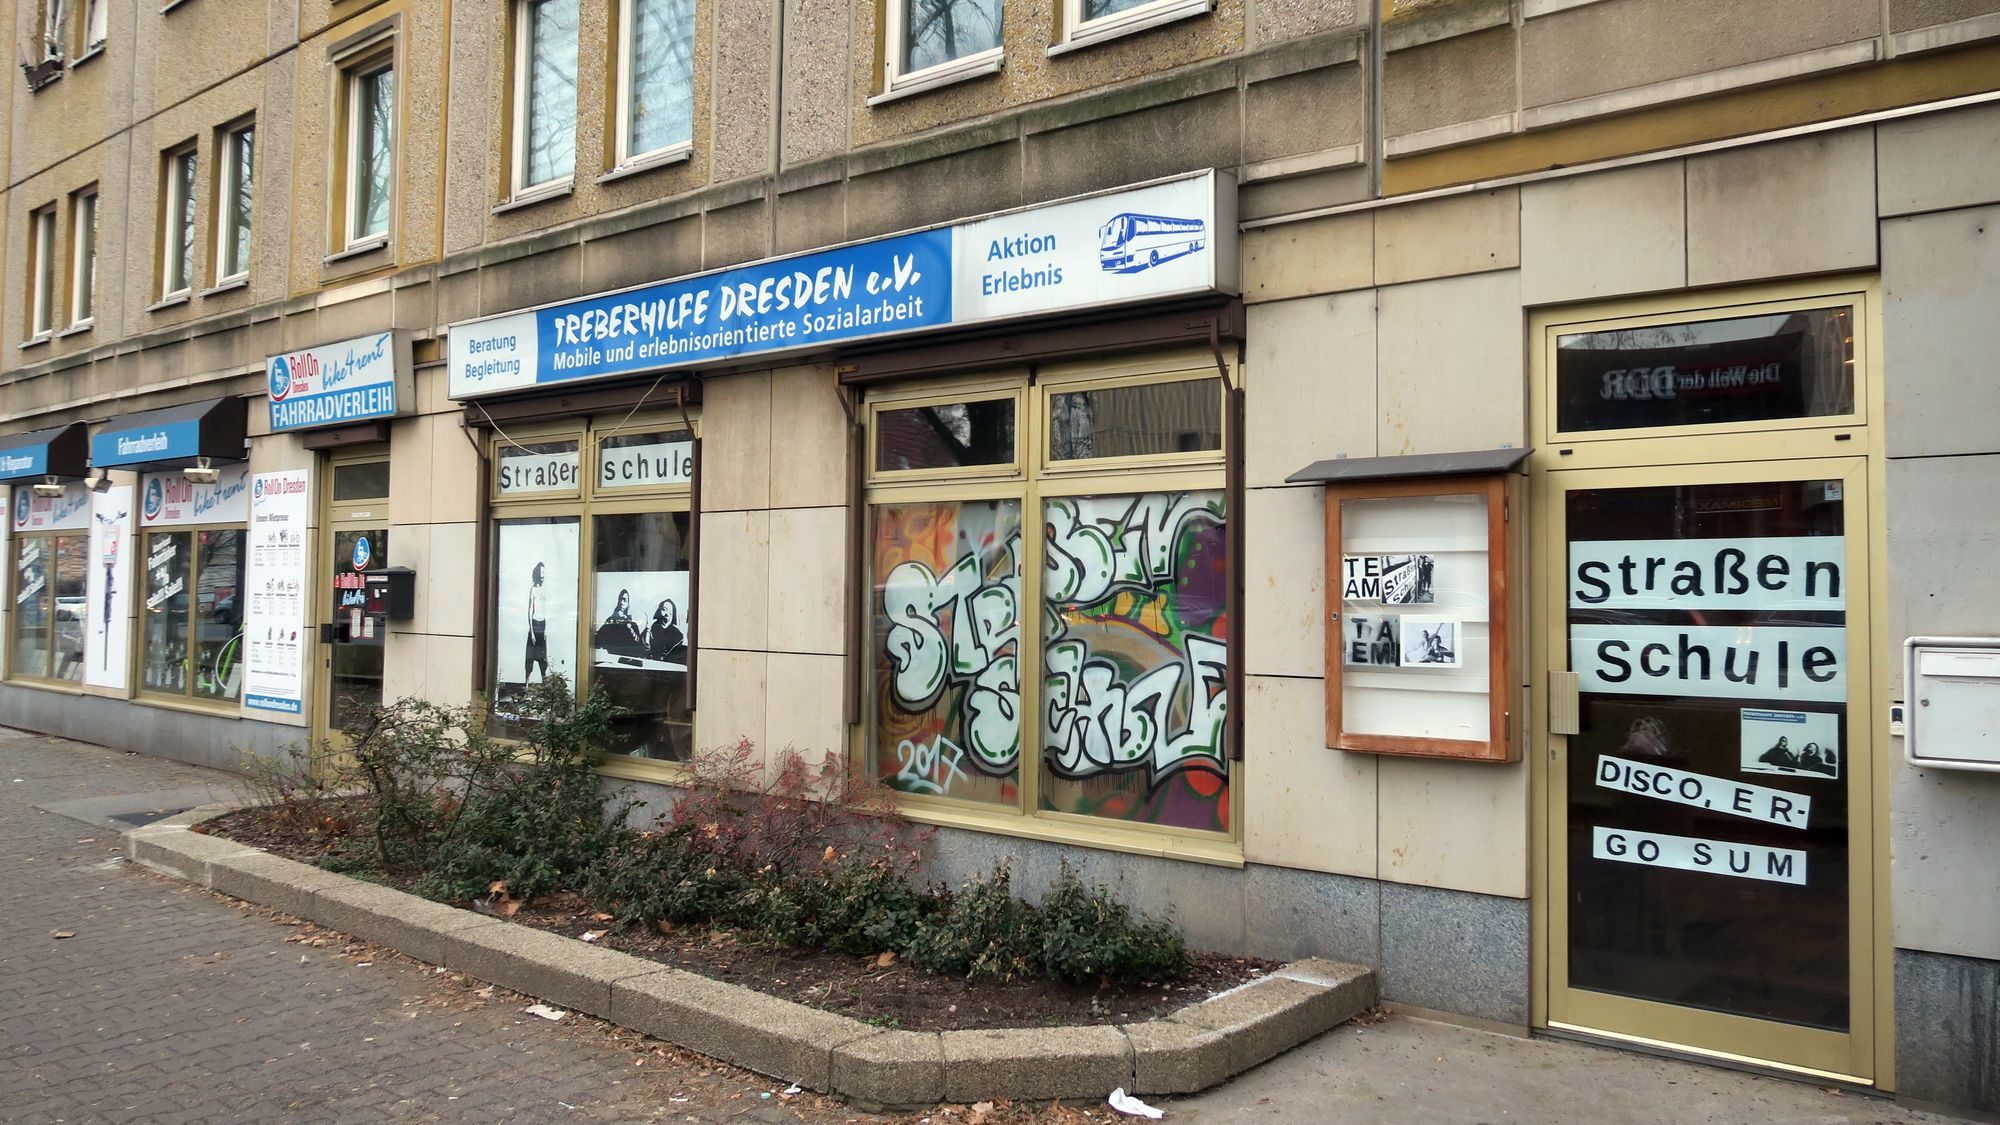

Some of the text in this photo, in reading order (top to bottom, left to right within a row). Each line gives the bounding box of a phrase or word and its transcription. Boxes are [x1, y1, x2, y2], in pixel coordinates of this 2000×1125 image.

[987, 233, 1056, 262] Aktion
[982, 264, 1063, 296] Erlebnis
[555, 253, 922, 347] TREBERHILFE DRESDEN e.V.
[469, 334, 517, 354] Beratung
[553, 296, 923, 371] Mobile und erlebnisorientierte Sozialarbeit
[465, 357, 521, 381] Begleitung
[272, 386, 393, 428] FAHRRADVERLEIH
[1344, 557, 1380, 578] TE
[1344, 578, 1380, 598] AM
[897, 734, 969, 794] 2017
[1600, 760, 1806, 823] DISCO, ER-
